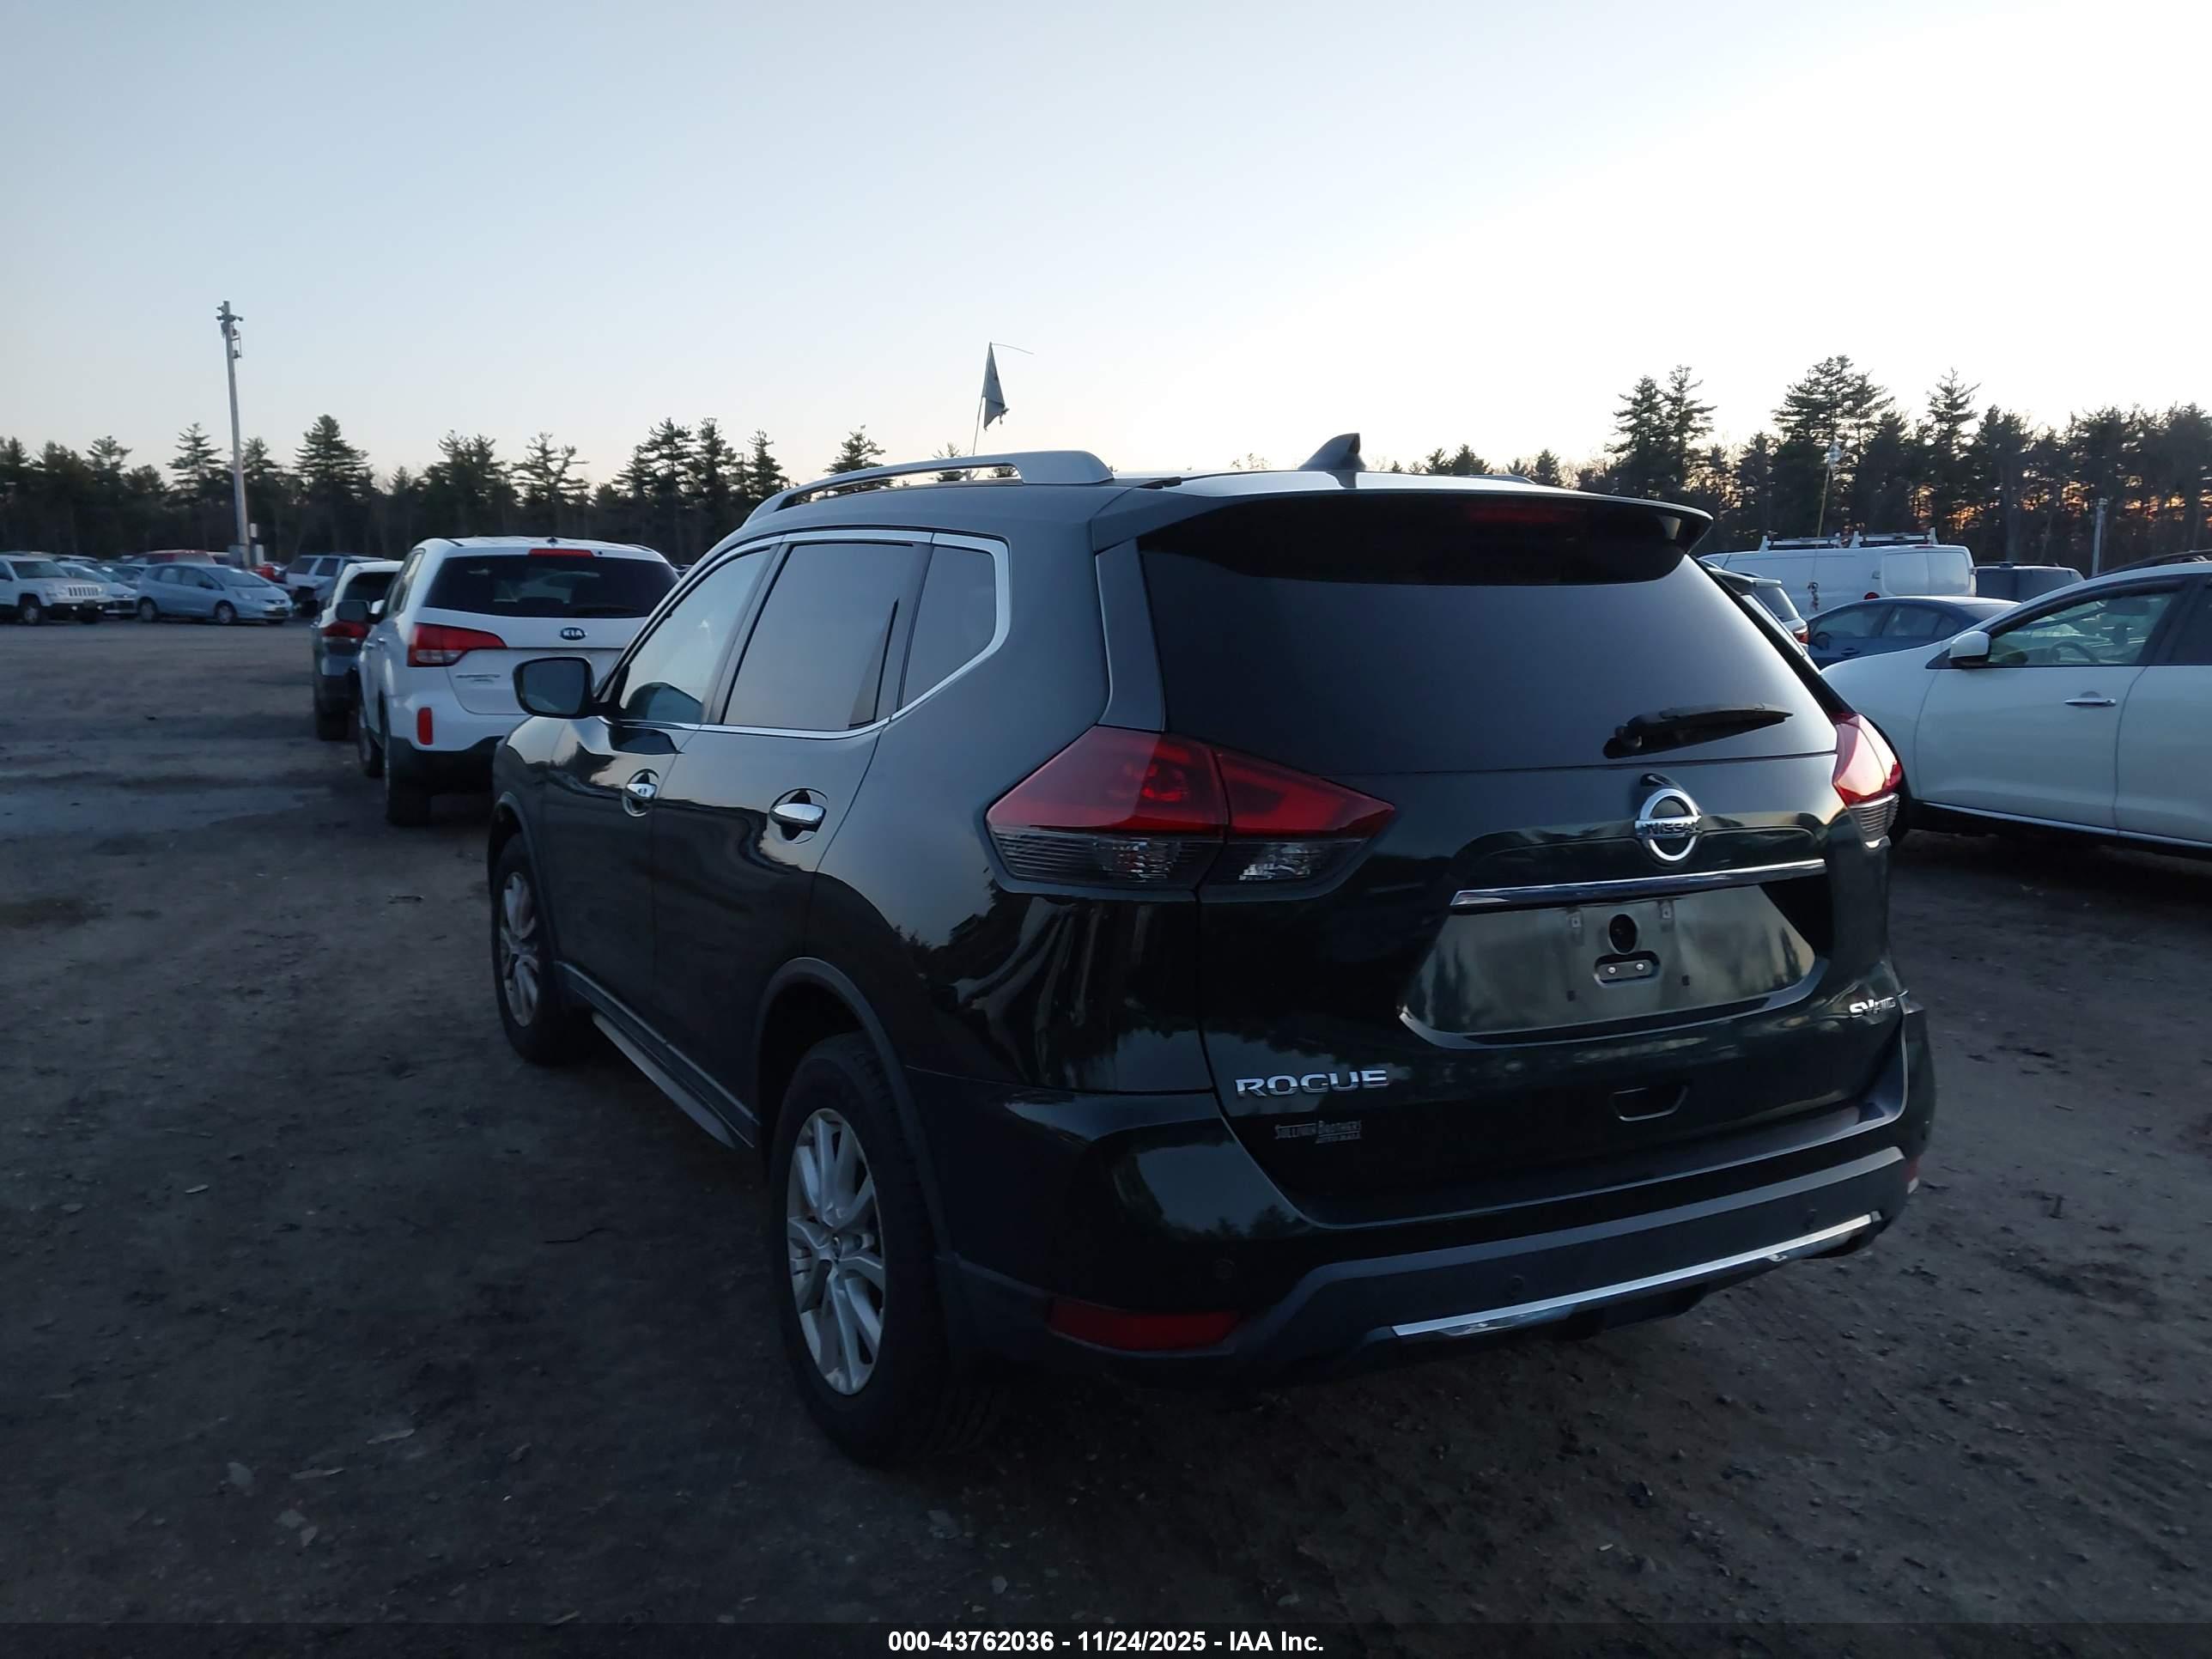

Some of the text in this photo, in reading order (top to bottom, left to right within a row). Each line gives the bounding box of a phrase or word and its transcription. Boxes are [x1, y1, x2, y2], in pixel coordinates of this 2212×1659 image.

[562, 629, 584, 637] KIA
[1644, 821, 1701, 837] NISSAN
[1234, 1069, 1390, 1097] ROGUE
